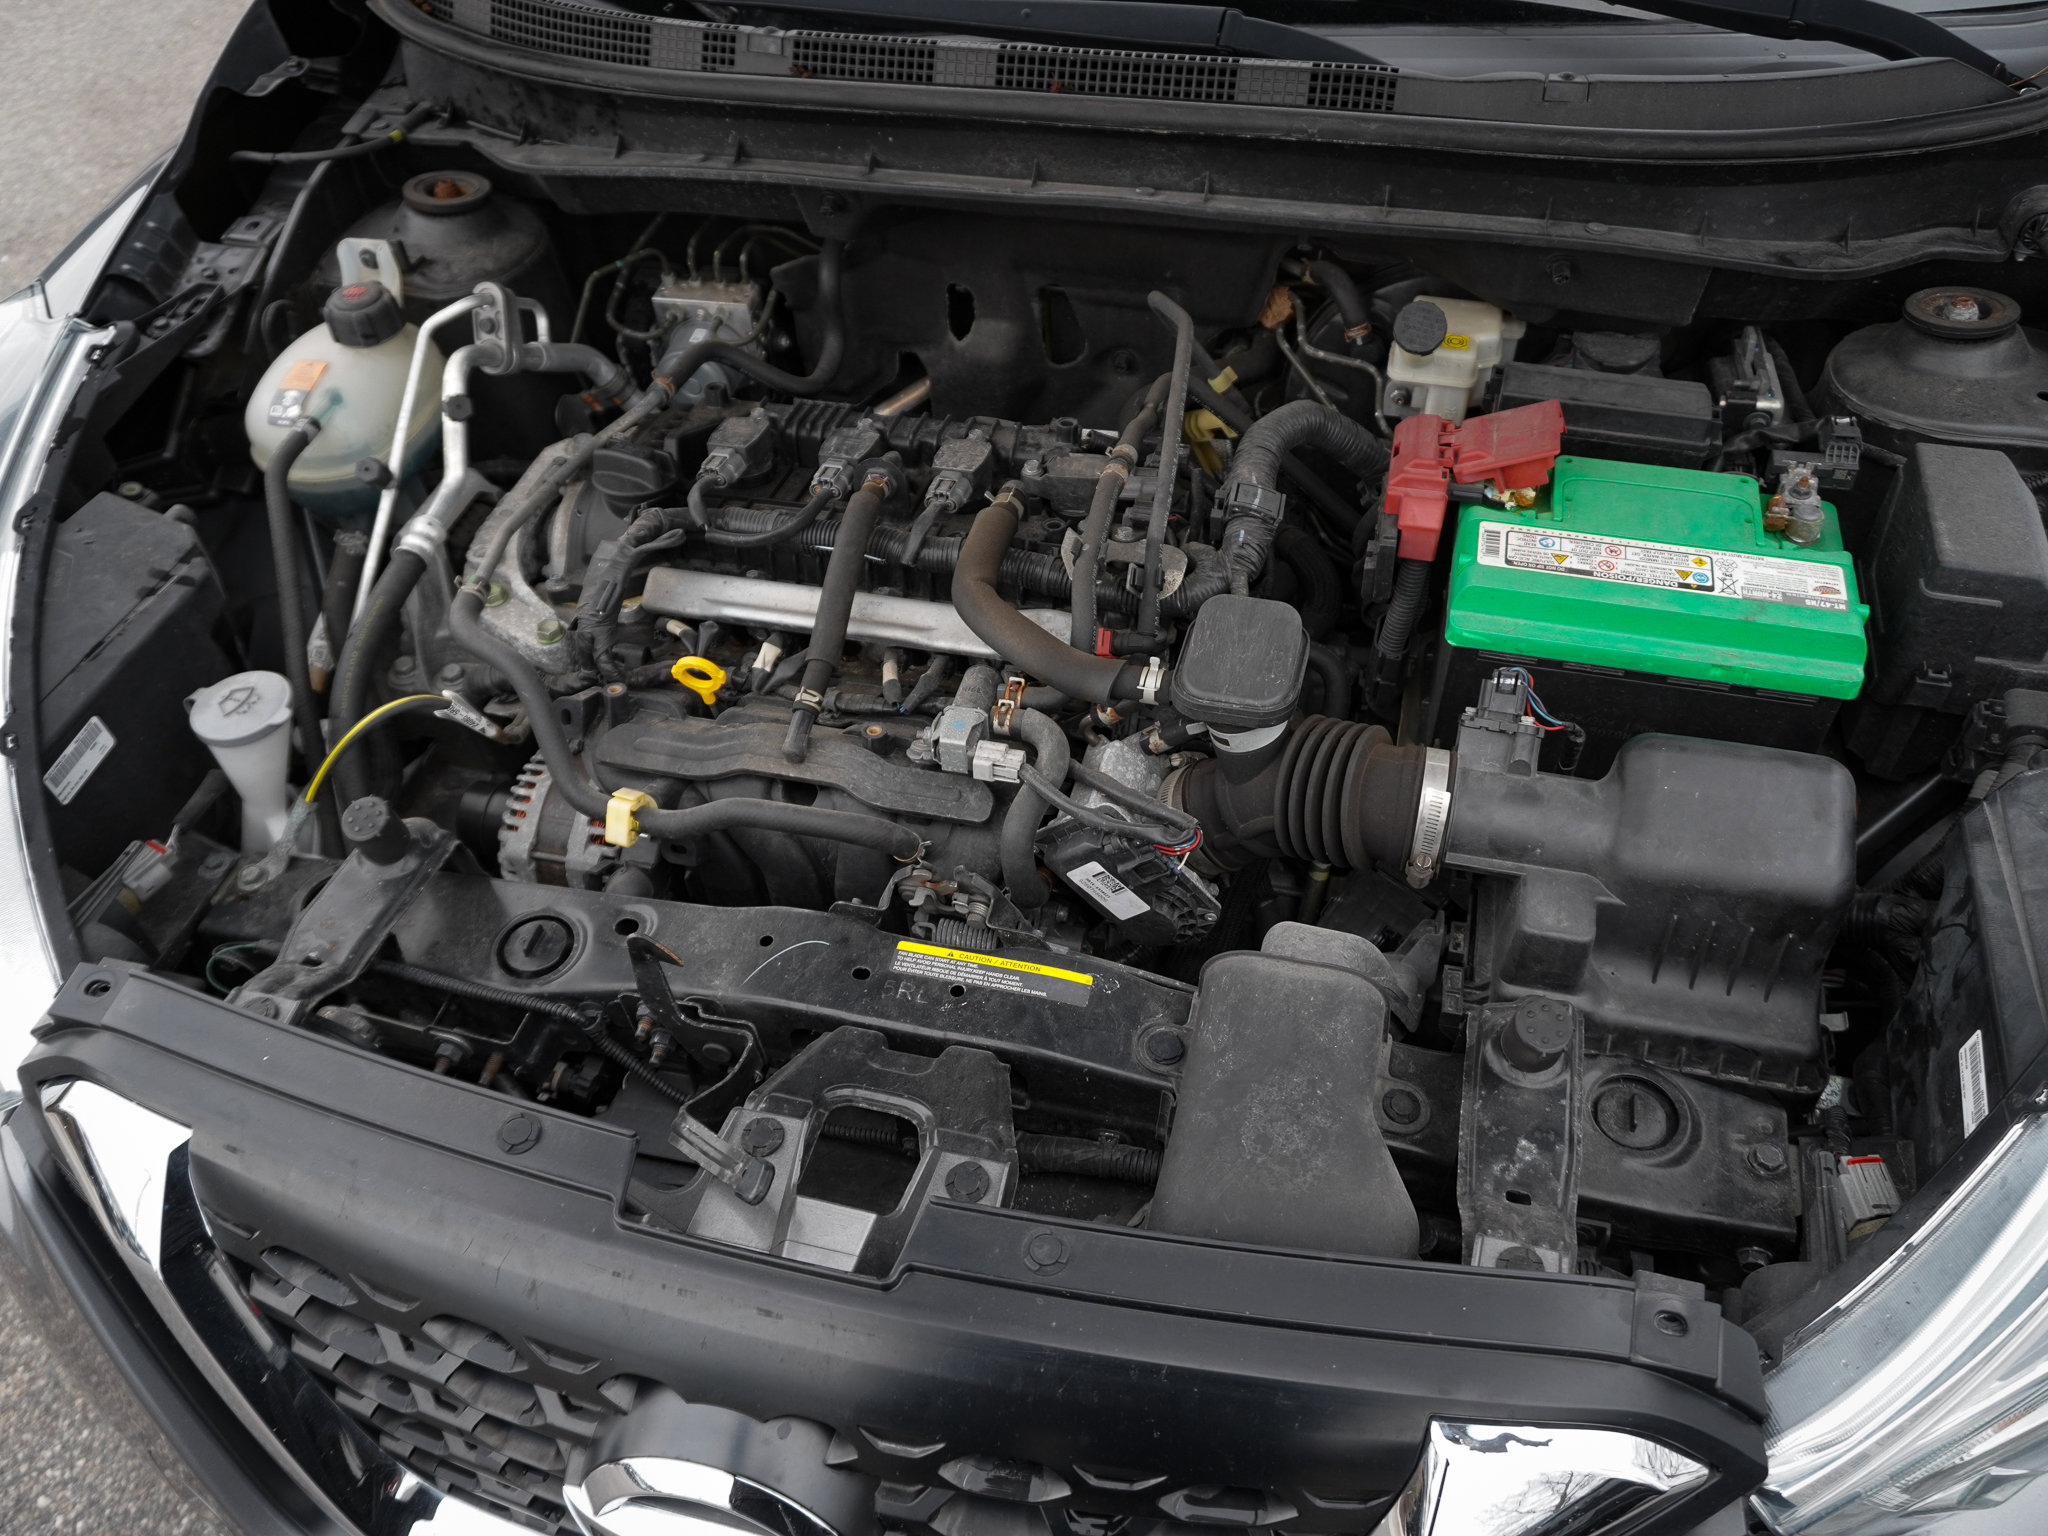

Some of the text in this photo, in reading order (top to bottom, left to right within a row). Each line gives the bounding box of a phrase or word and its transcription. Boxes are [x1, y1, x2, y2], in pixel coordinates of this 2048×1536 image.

[1592, 570, 1678, 587] DANGER/POISON
[900, 961, 931, 970] VENTILATEUR
[931, 961, 957, 969] PERSONAL
[958, 952, 992, 963] CAUTION
[999, 959, 1041, 972] ATTENTION
[990, 982, 1021, 992] APPROCHER
